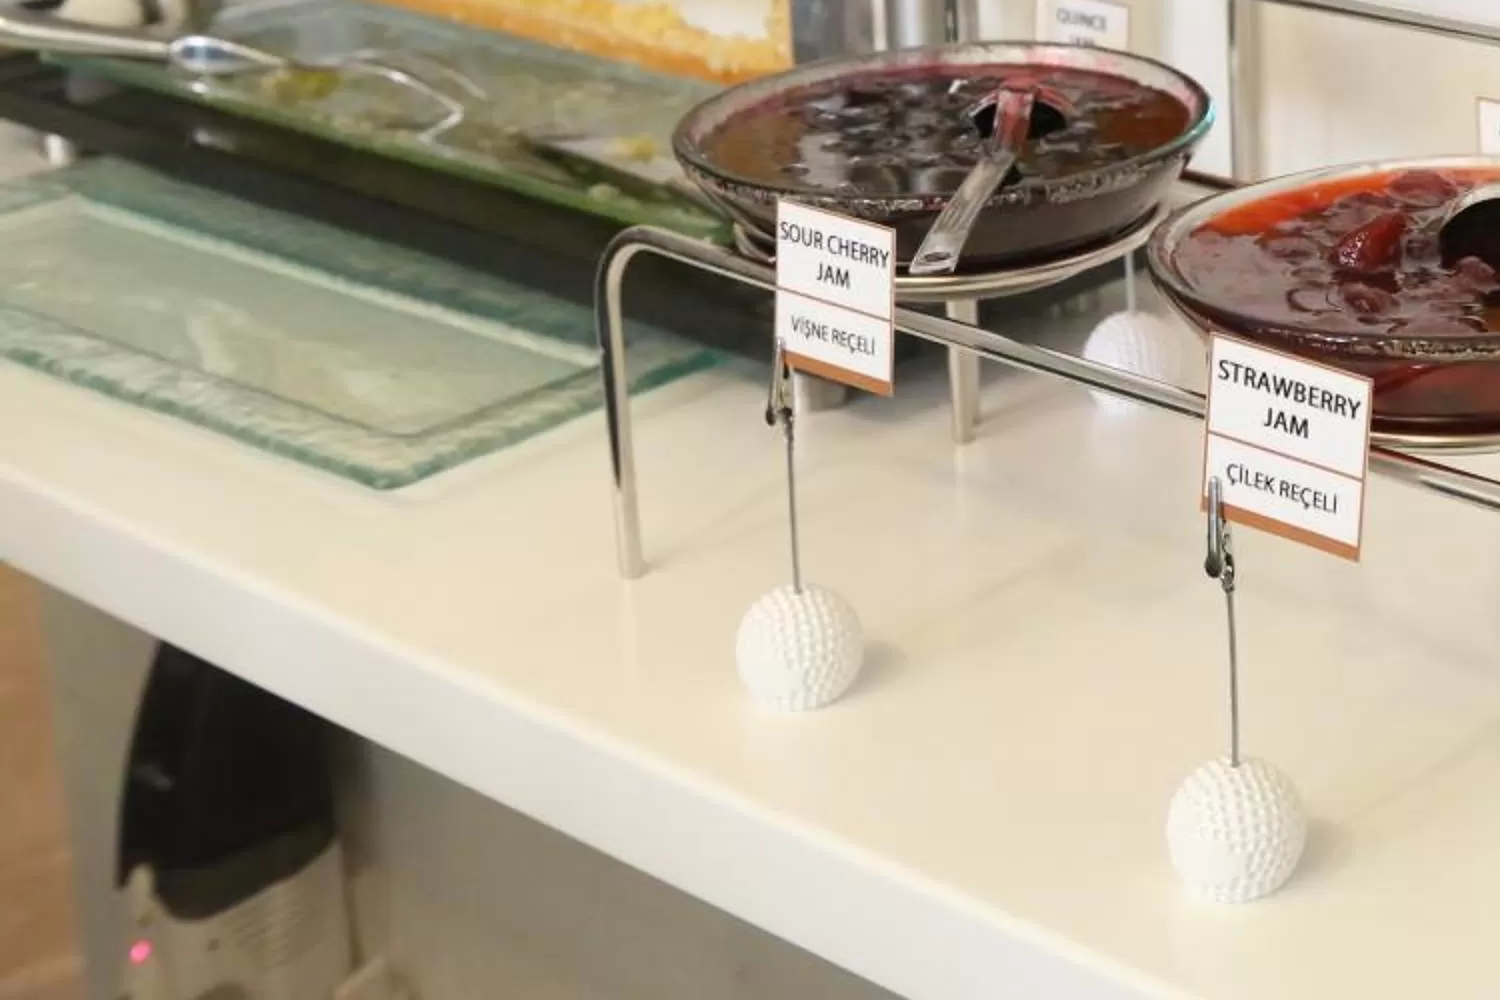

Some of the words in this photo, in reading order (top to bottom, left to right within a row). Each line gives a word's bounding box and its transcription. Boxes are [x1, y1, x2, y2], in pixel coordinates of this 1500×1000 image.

[779, 221, 823, 251] SOUR
[827, 235, 890, 269] CHERRY
[816, 263, 850, 290] JAM
[1218, 359, 1361, 420] STRAWBERRY
[1264, 407, 1309, 439] JAM
[1226, 463, 1276, 495] ÇİLEK
[1279, 480, 1337, 514] REÇELİ
